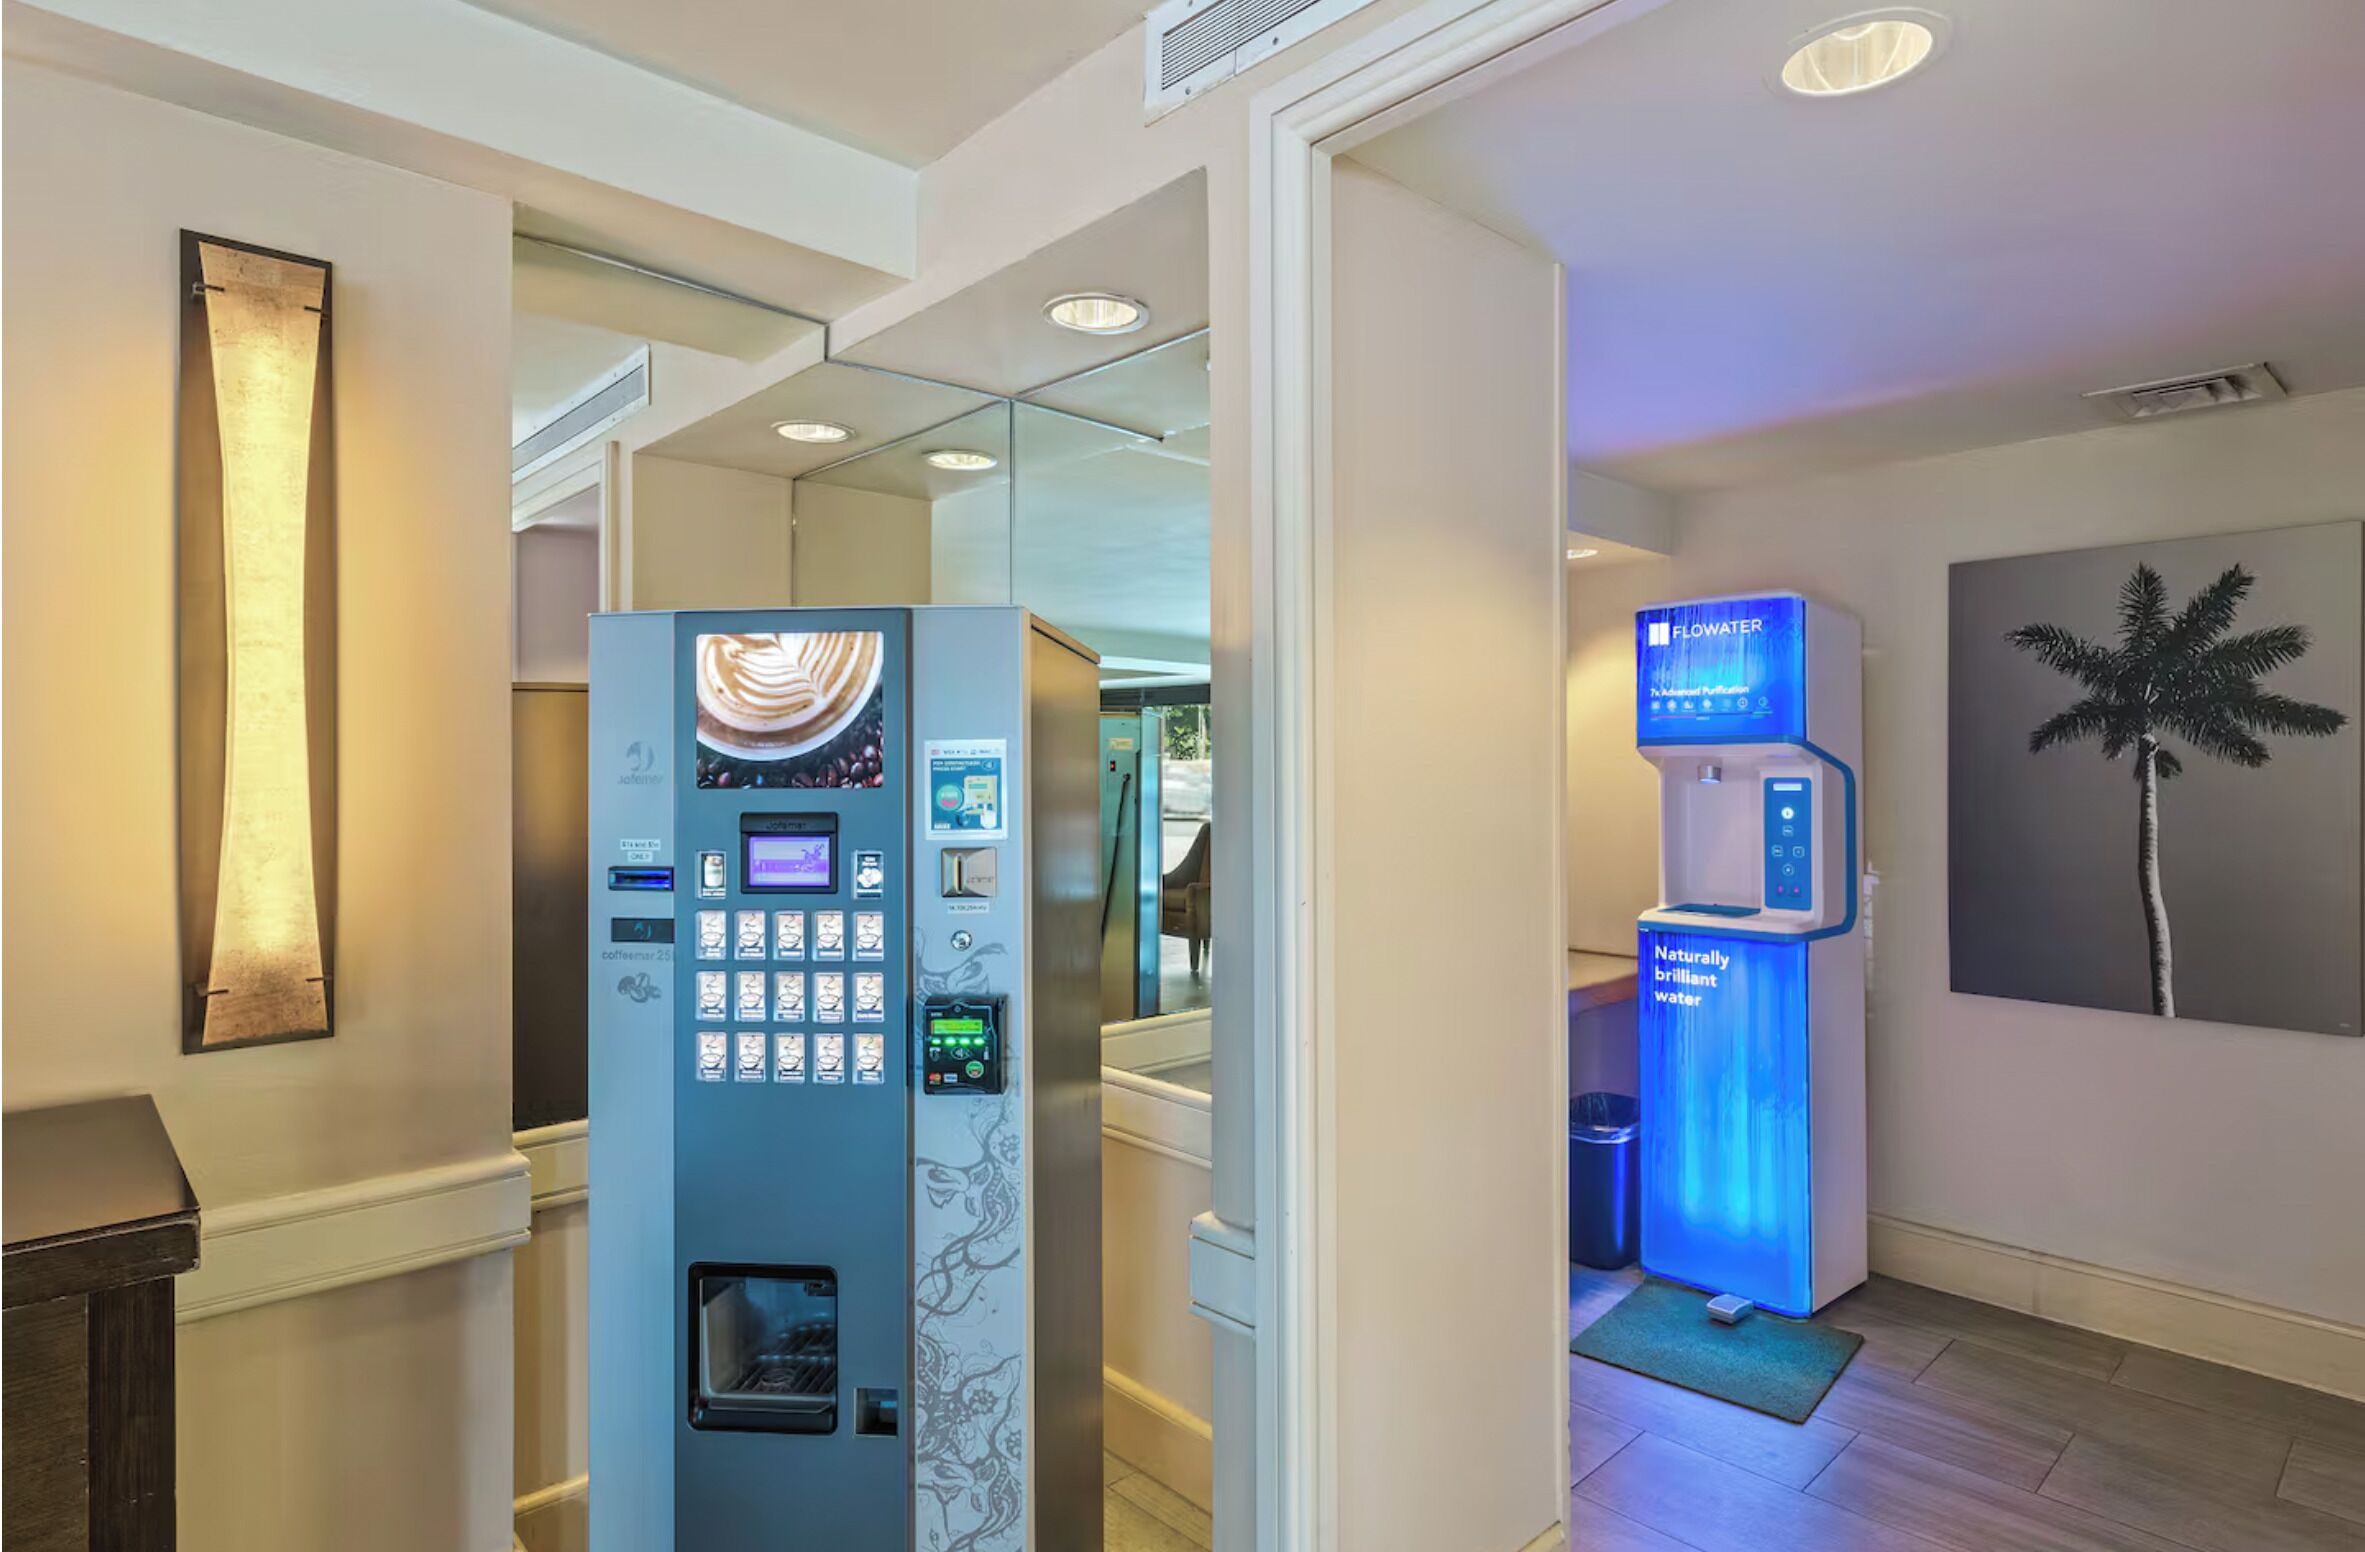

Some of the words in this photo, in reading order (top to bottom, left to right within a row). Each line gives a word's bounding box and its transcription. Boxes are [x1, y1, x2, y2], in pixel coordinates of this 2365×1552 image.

[1672, 618, 1763, 639] FLOWATER
[1650, 688, 1660, 697] 7x
[1661, 687, 1700, 697] Advanced
[1702, 684, 1750, 695] Purification
[1654, 944, 1730, 971] Naturally
[1654, 965, 1718, 989] brilliant
[1654, 990, 1703, 1008] water
